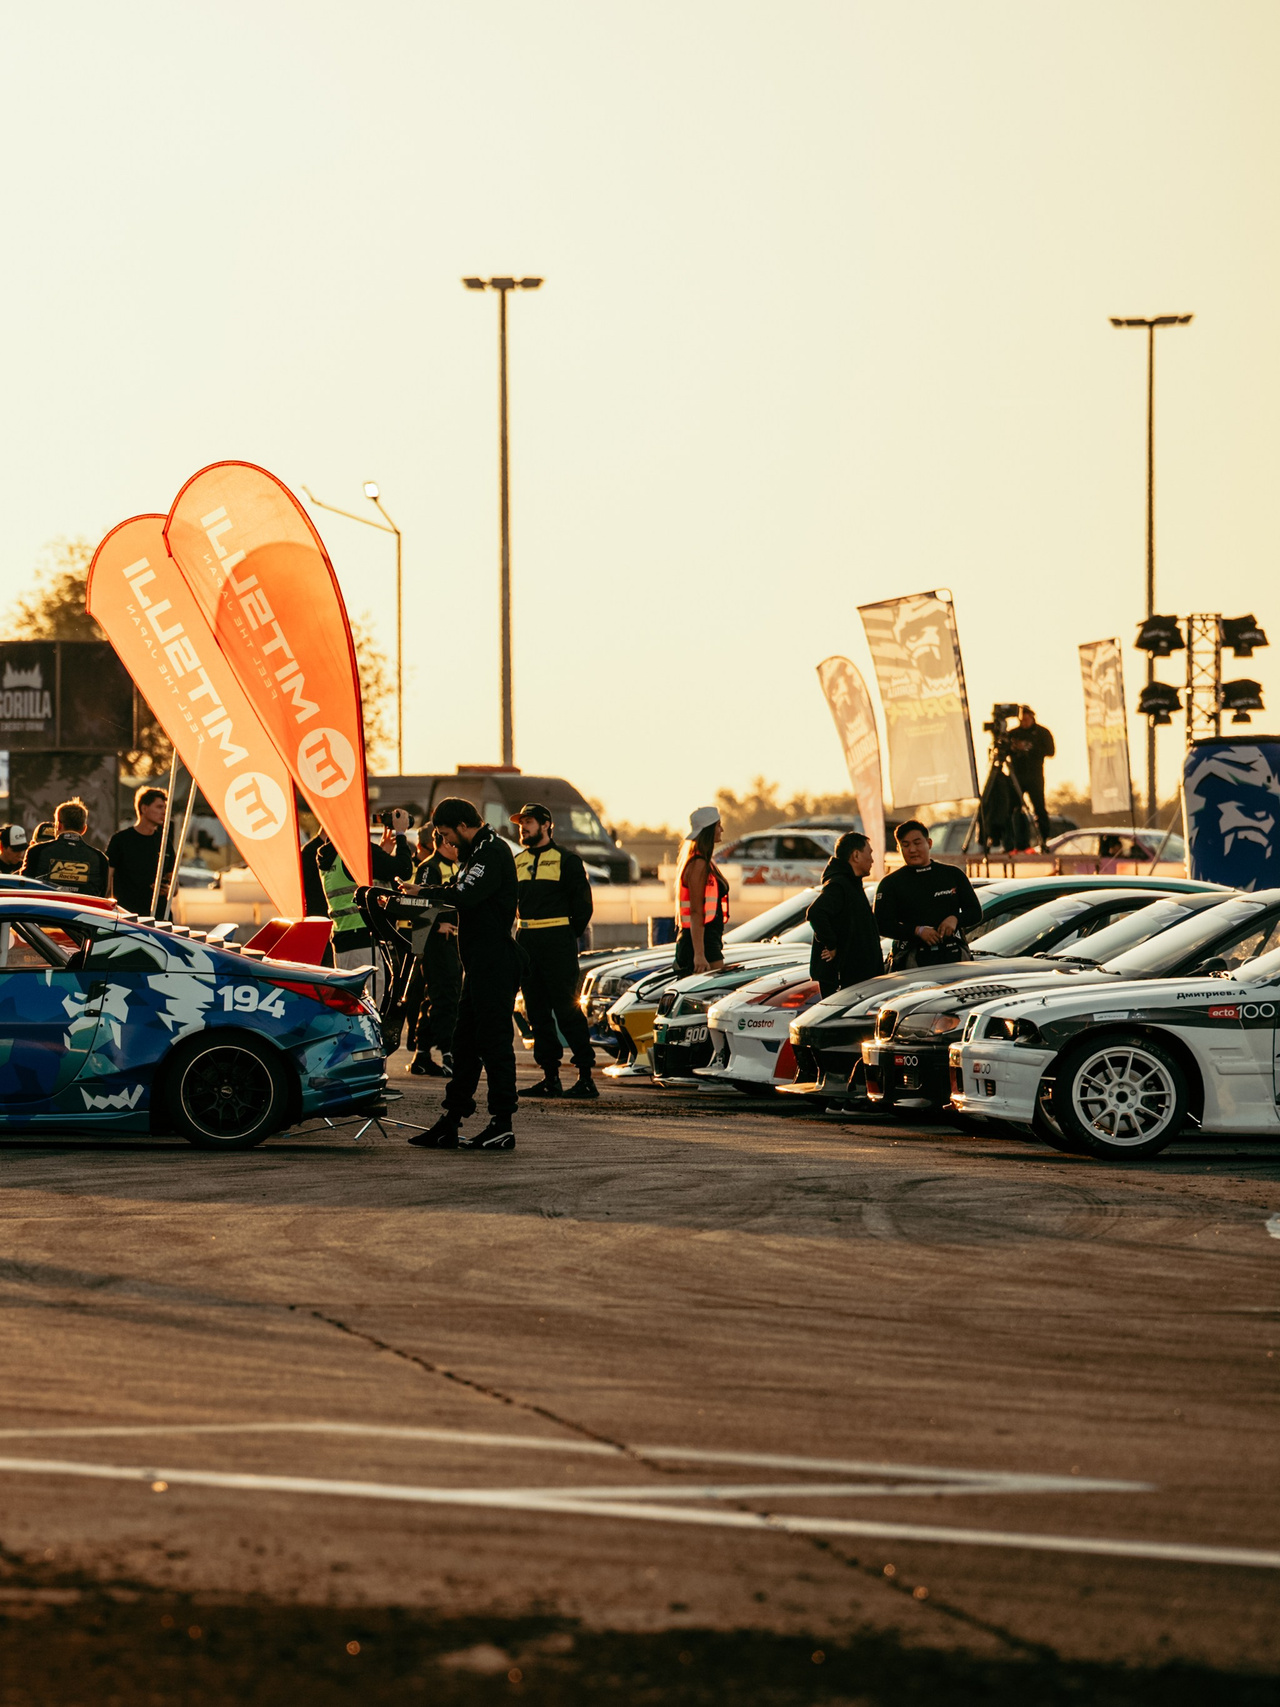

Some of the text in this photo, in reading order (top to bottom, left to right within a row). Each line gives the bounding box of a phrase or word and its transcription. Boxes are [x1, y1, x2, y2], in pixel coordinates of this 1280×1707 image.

[51, 861, 89, 874] ASP
[217, 985, 285, 1019] 194
[1176, 991, 1235, 1000] Дмитриев.
[747, 1019, 775, 1028] Castrol
[685, 1026, 708, 1042] 900
